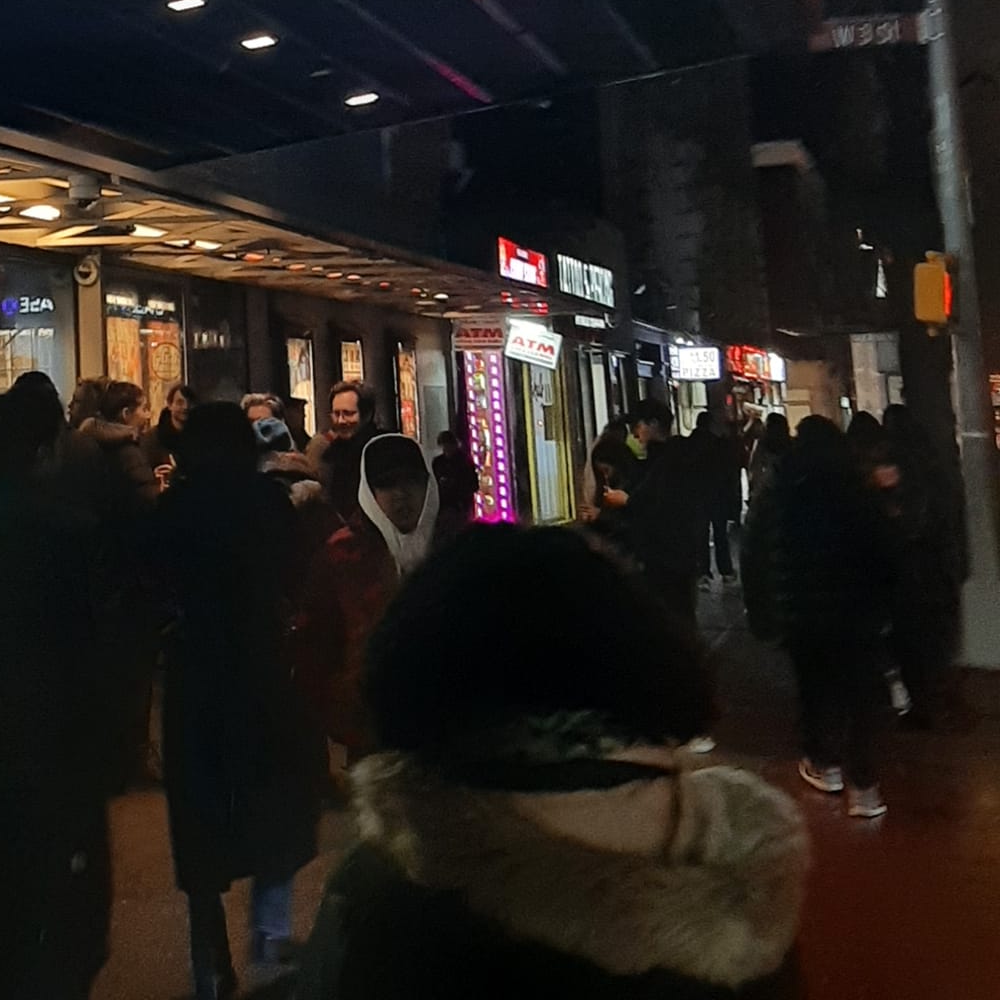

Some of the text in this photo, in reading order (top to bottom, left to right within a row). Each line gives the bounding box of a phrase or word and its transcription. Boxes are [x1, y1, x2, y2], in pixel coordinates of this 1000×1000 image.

[832, 25, 854, 48] W
[859, 22, 872, 46] 3
[456, 328, 503, 338] ATM
[512, 336, 554, 356] ATM
[682, 367, 716, 378] PIZZA
